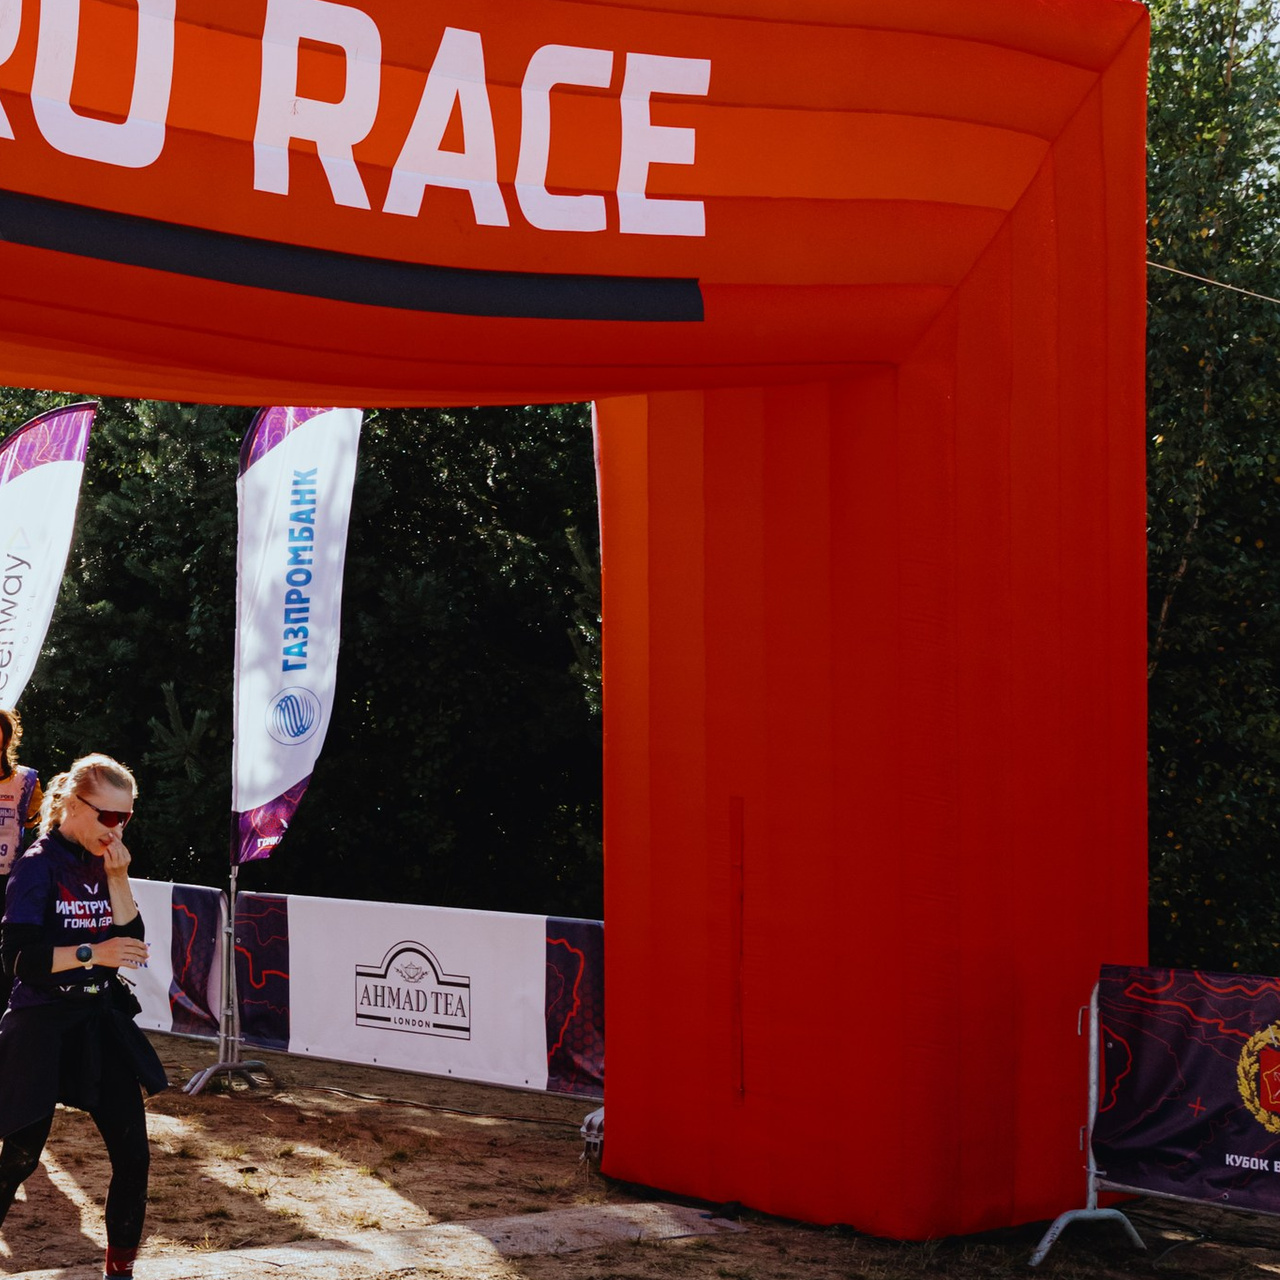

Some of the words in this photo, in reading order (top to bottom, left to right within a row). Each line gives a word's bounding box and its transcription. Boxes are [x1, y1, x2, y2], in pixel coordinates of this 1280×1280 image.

[282, 467, 318, 673] ГАЗПРОМБАНК
[64, 918, 96, 929] ГОНКА
[359, 983, 428, 1013] AHMAD
[430, 990, 467, 1018] TEA
[393, 1017, 431, 1029] LONDON
[1225, 1153, 1270, 1172] КУБОК
